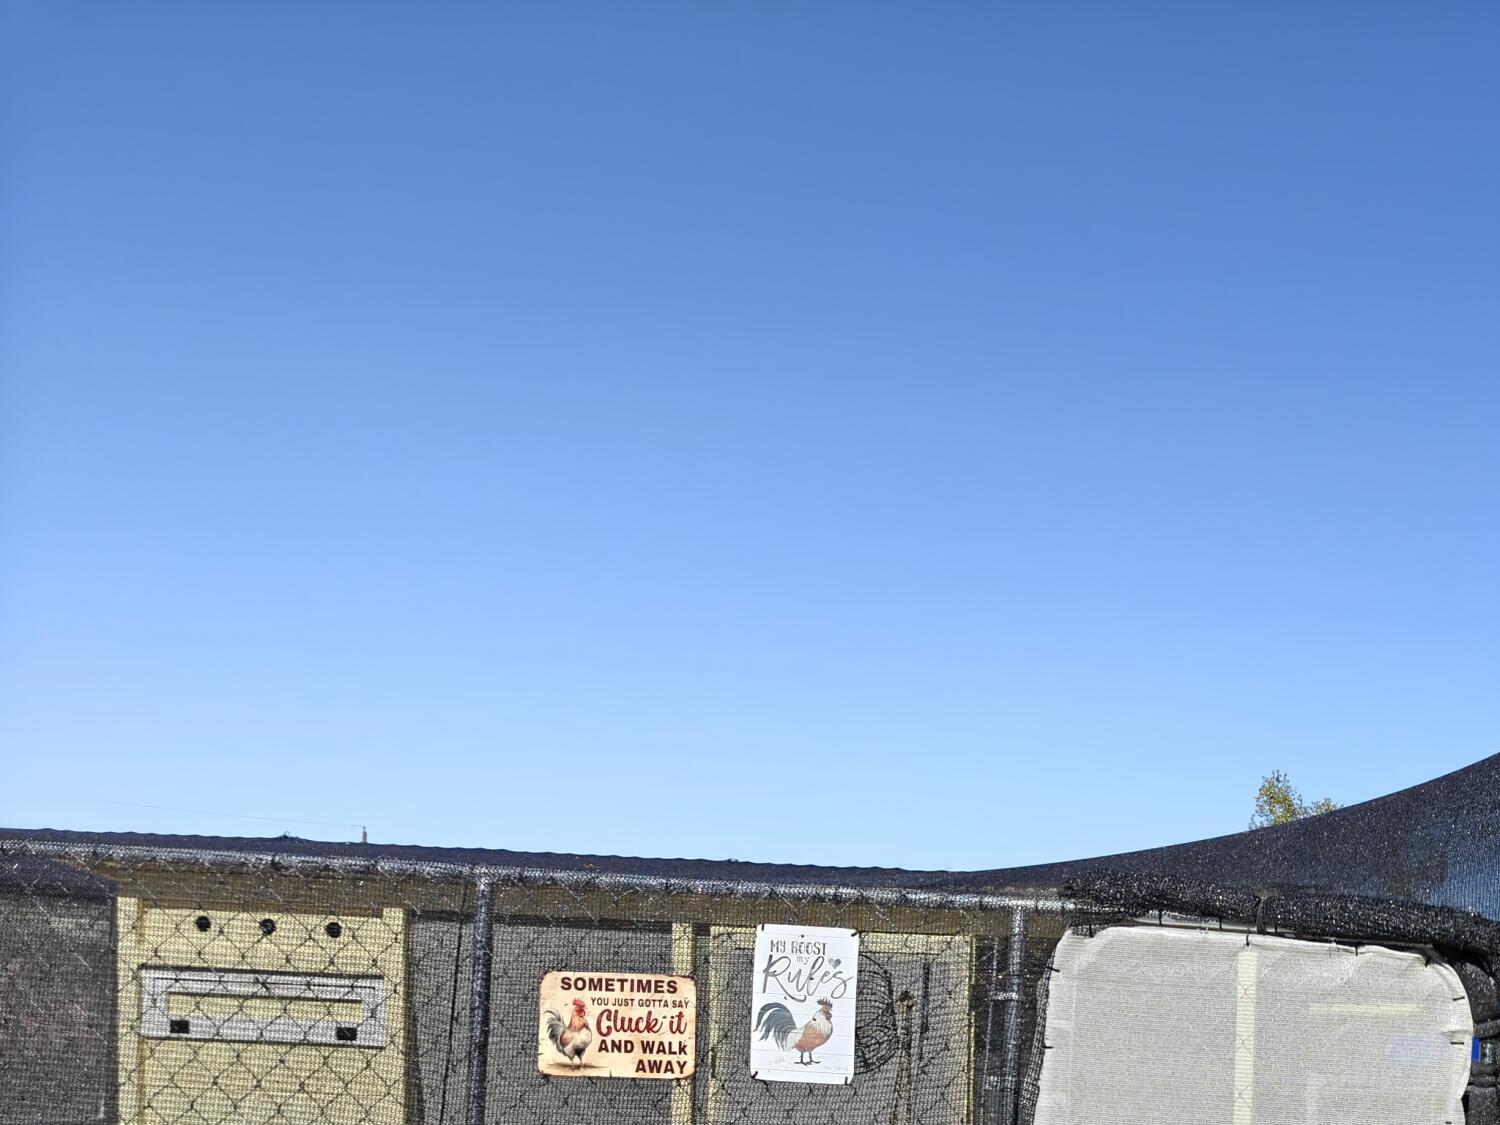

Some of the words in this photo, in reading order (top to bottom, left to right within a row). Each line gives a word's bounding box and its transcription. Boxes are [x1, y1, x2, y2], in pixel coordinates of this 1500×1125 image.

[770, 939, 786, 953] MY
[791, 940, 828, 955] ROOST
[560, 976, 678, 994] SOMETIMES
[763, 954, 853, 1003] Rules
[591, 997, 609, 1007] YOU
[612, 998, 635, 1008] JUST
[638, 999, 669, 1008] GOTTA
[672, 1000, 690, 1009] SAY
[596, 1008, 664, 1037] Cluck
[669, 1011, 687, 1035] it
[598, 1039, 635, 1054] AND
[641, 1040, 688, 1056] WALK
[635, 1059, 688, 1074] AWAY
